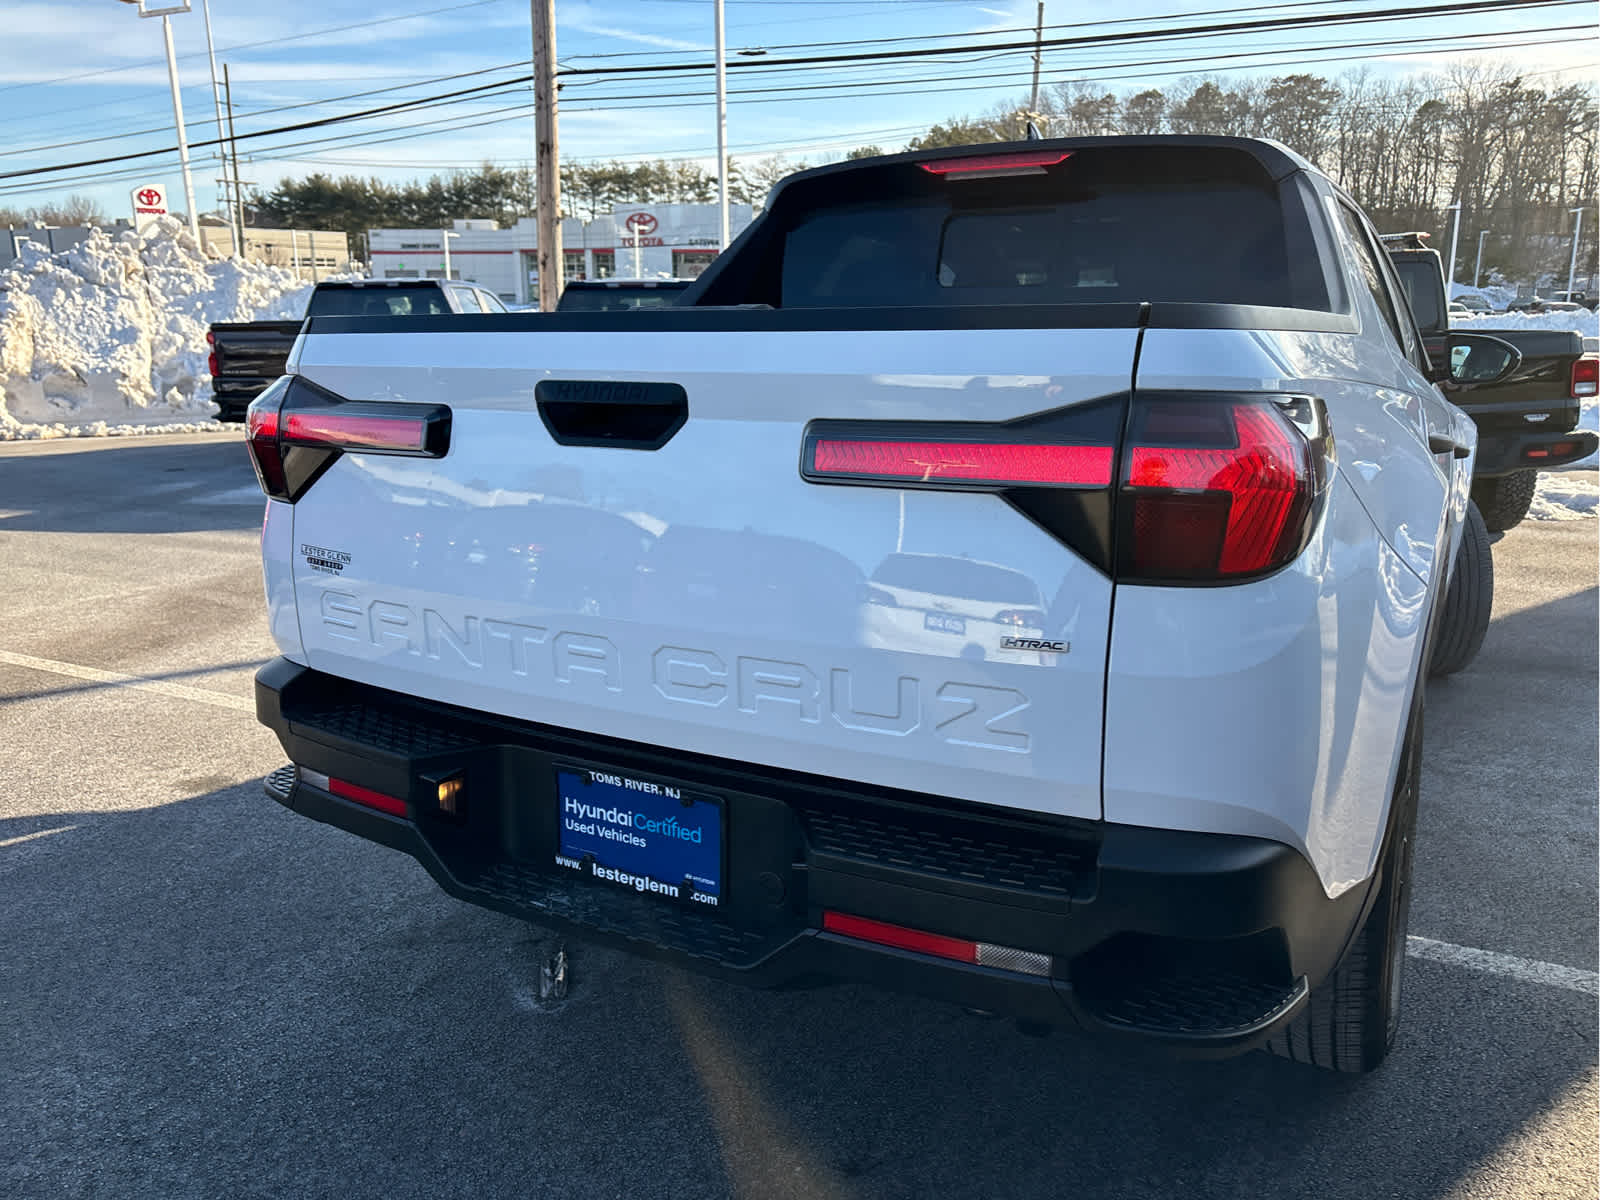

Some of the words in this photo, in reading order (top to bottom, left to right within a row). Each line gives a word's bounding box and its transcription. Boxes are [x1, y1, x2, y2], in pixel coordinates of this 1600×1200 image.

[557, 383, 649, 401] HYUNDAI
[1004, 638, 1064, 651] HTRAC
[320, 590, 622, 692] SANTA
[652, 645, 1031, 754] CRUZ
[589, 771, 622, 787] TOMS
[625, 779, 662, 795] RIVER,
[665, 787, 681, 799] NJ
[565, 797, 632, 827] Hyundai
[634, 813, 701, 843] Certified
[565, 818, 595, 836] Used
[596, 825, 647, 848] Vehicles
[555, 855, 582, 871] www.
[592, 863, 679, 897] lesterglenn
[690, 892, 718, 906] .com
